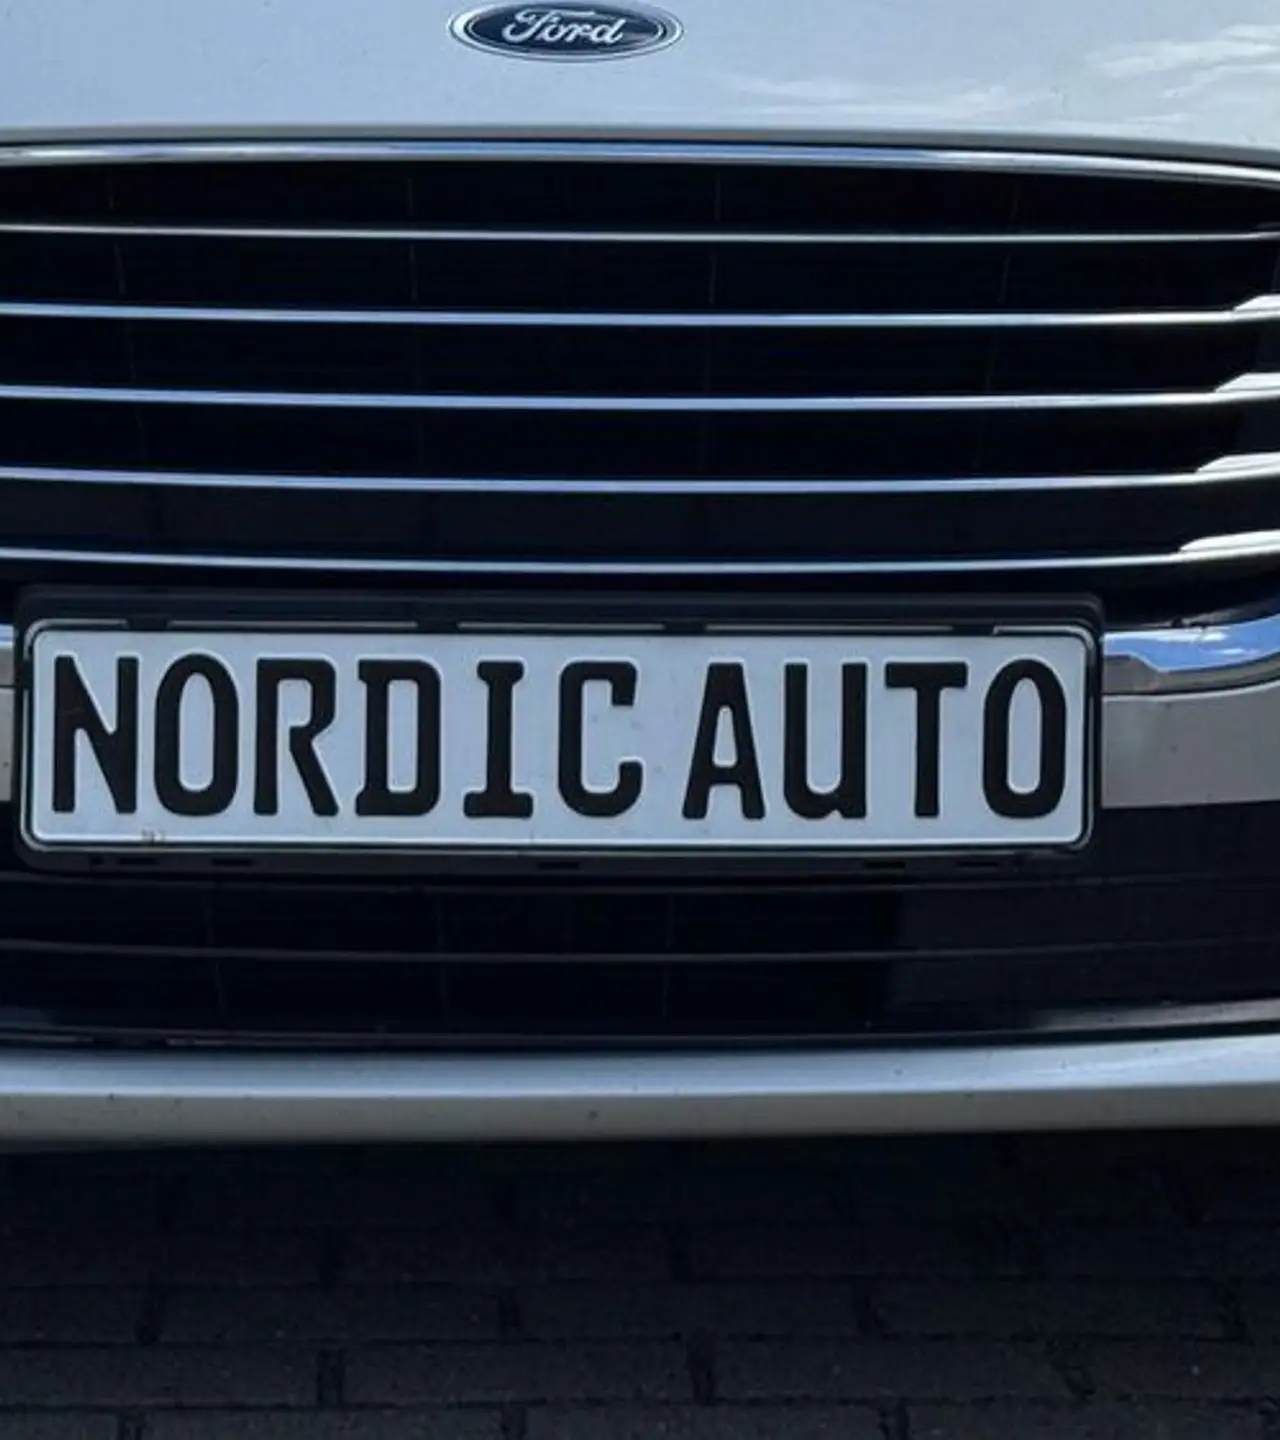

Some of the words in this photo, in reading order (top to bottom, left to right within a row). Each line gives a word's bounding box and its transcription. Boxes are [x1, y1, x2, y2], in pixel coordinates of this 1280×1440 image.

[502, 8, 627, 44] Ford
[51, 653, 643, 819] NORDIC
[681, 659, 1067, 821] AUTO
